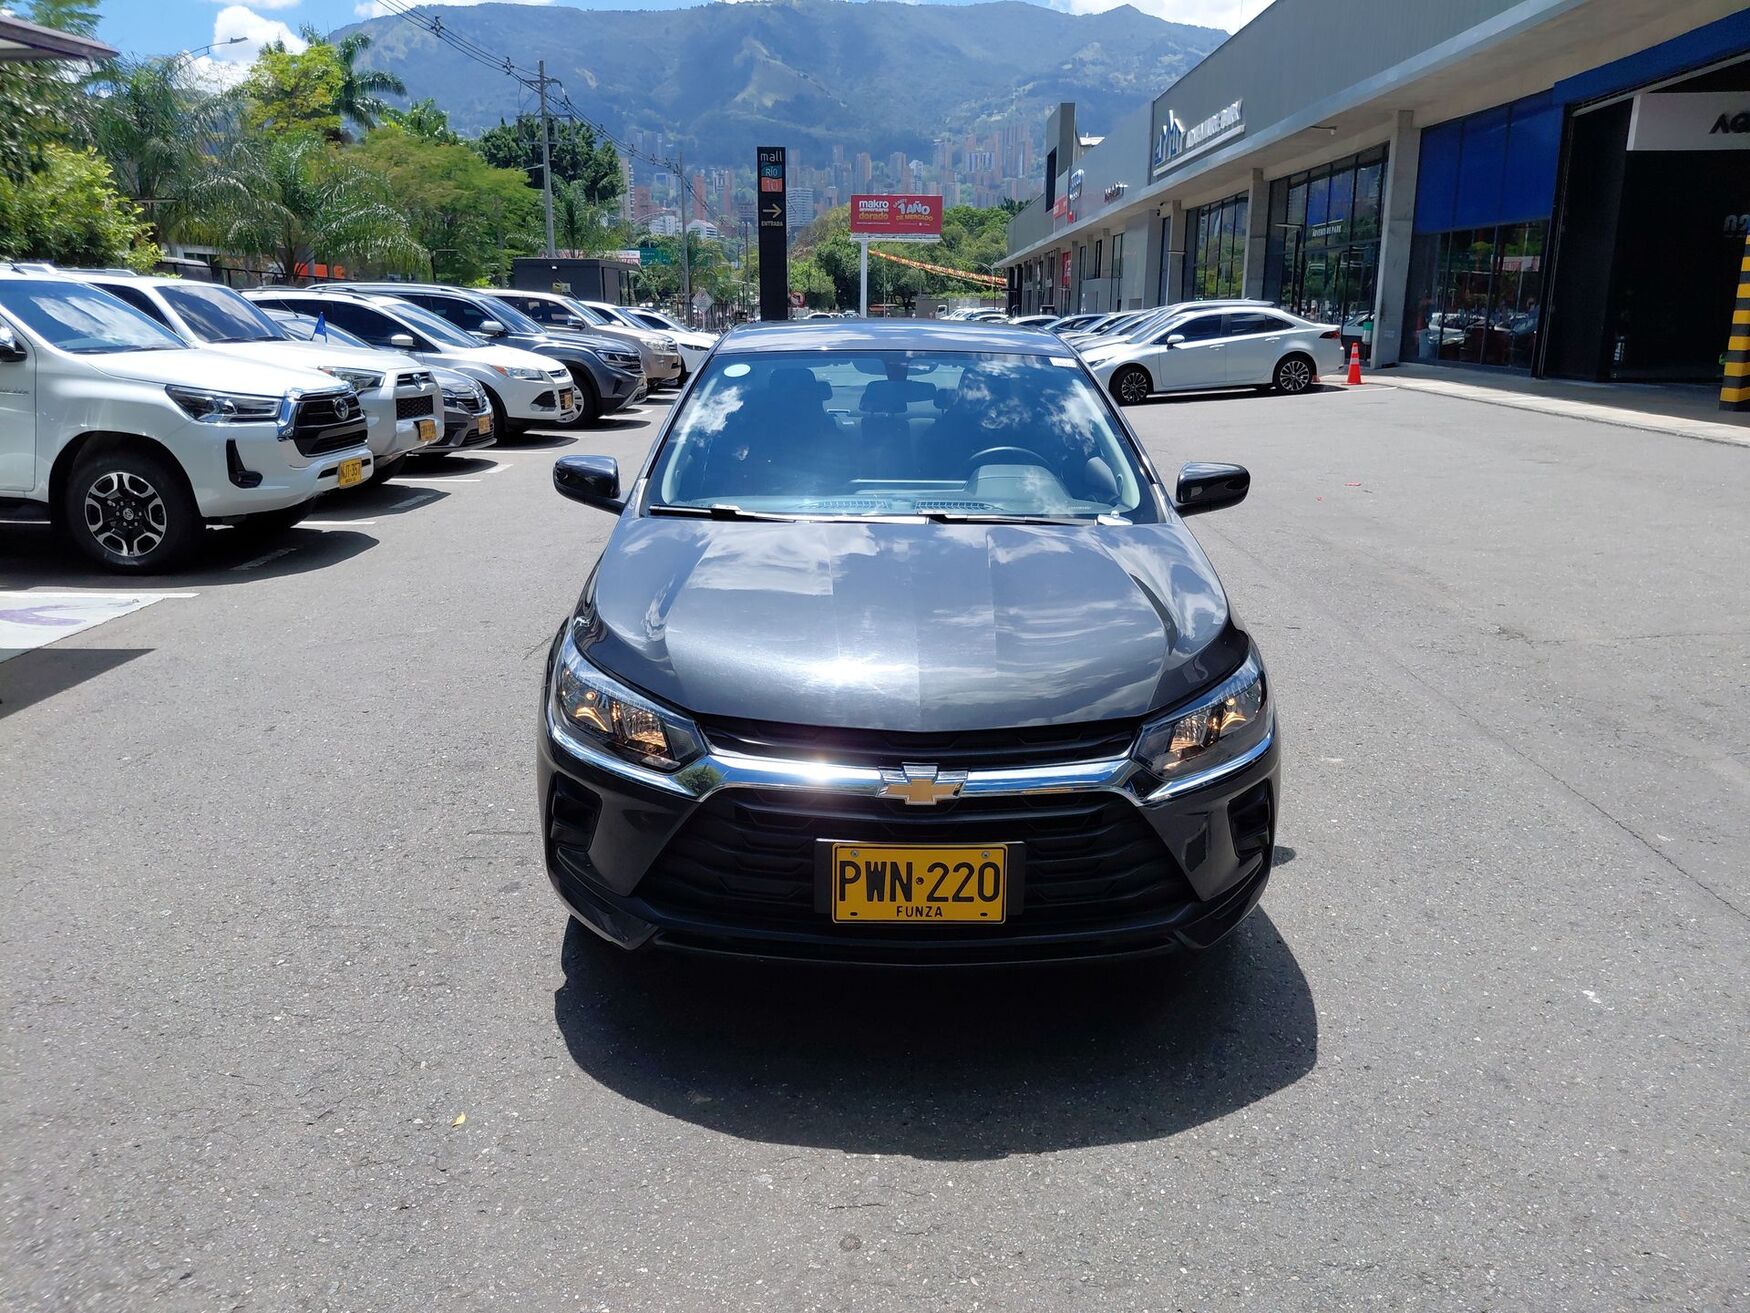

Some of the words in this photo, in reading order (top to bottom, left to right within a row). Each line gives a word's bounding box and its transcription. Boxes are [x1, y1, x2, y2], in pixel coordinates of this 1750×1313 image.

[760, 150, 783, 162] mall
[859, 200, 889, 208] makro
[906, 201, 931, 215] AÑO
[859, 212, 889, 220] dorado
[896, 905, 943, 918] FUNZA
